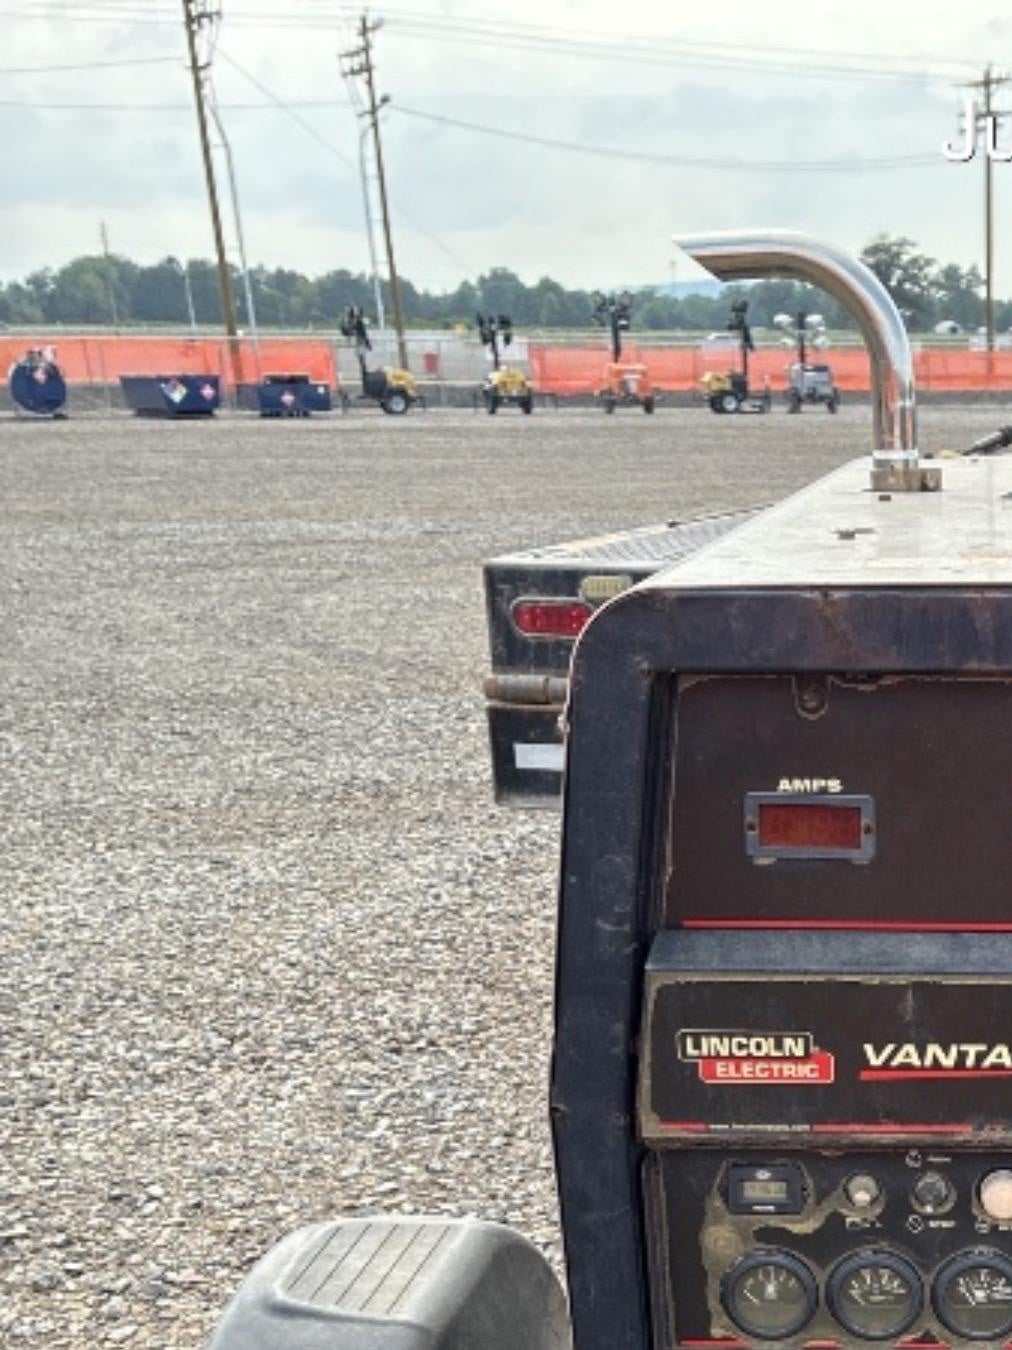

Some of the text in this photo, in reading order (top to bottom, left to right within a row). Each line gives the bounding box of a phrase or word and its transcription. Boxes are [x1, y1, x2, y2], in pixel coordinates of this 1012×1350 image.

[777, 778, 843, 794] AMPS
[685, 1034, 806, 1058] LINCOLN
[715, 1061, 820, 1079] ELECTRIC
